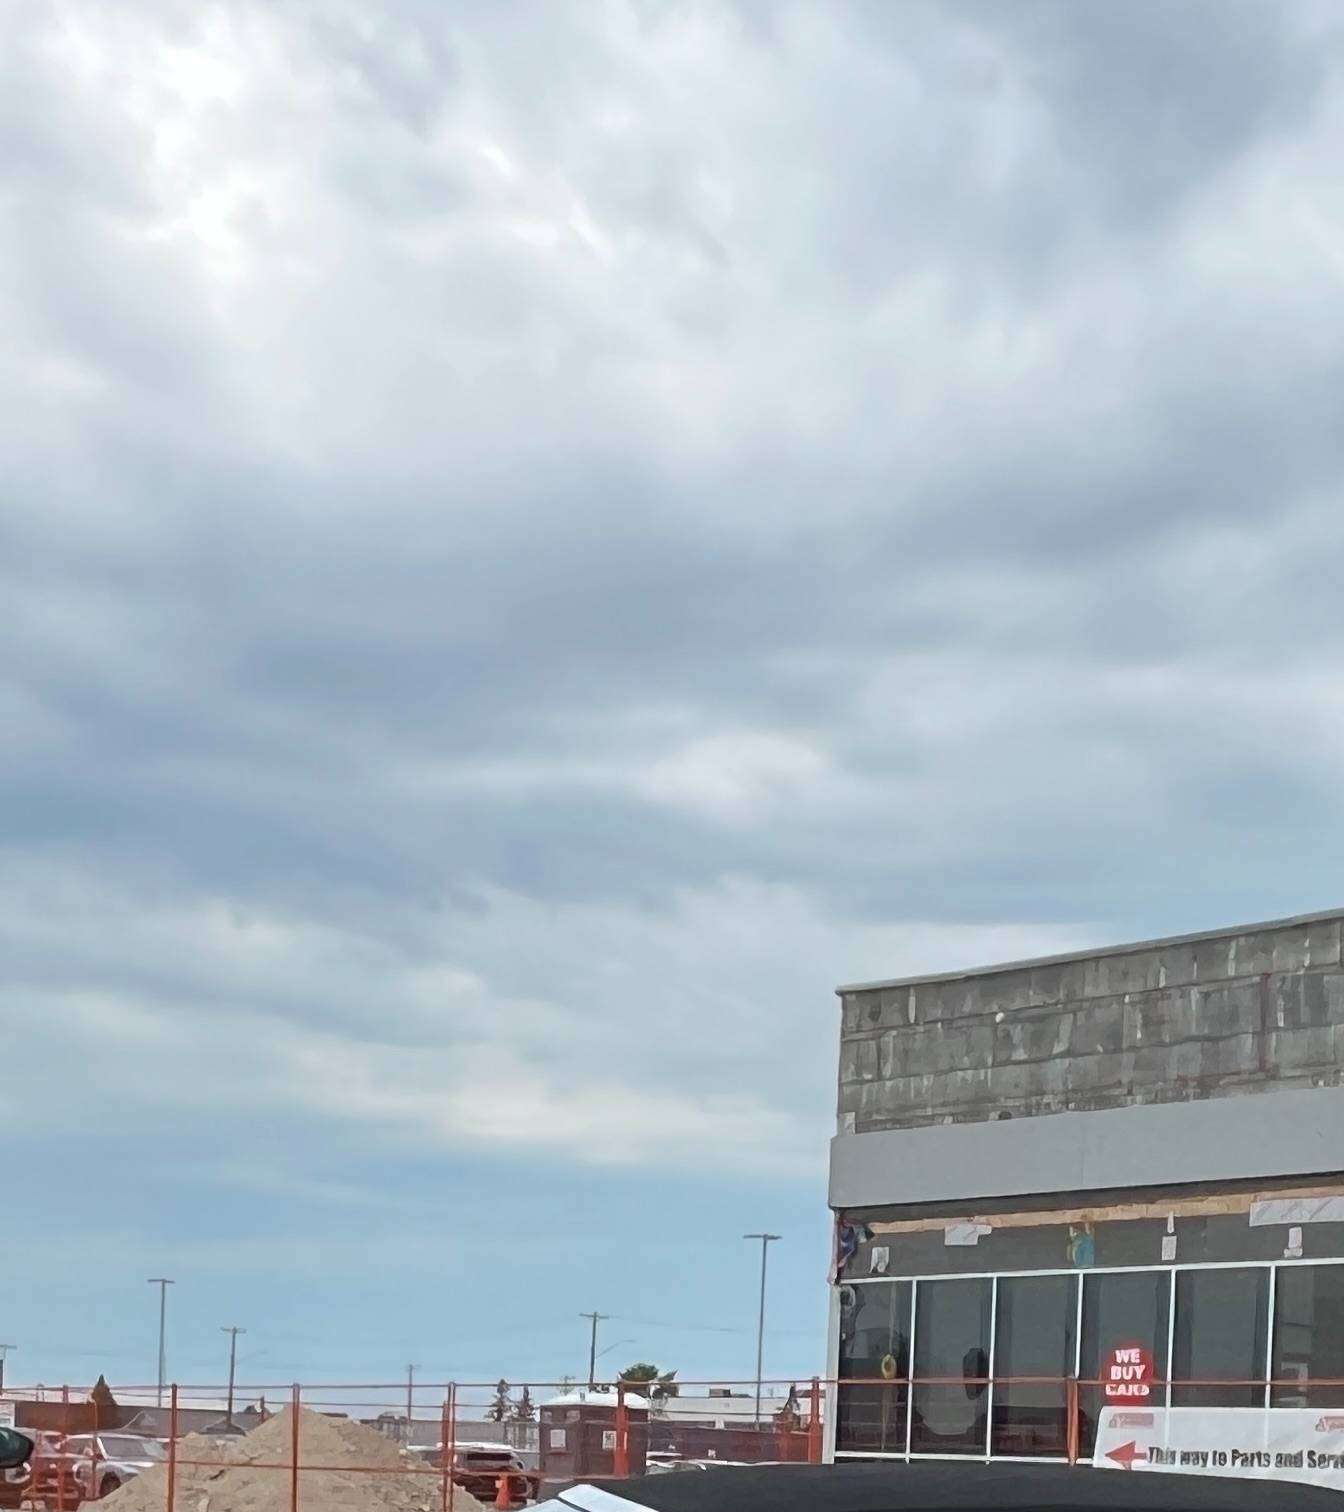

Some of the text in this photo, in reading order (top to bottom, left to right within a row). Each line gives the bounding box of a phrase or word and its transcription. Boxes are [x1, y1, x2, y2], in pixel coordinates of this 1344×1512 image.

[1115, 1348, 1141, 1364] WE
[1110, 1365, 1146, 1381] BUY
[1147, 1446, 1175, 1466] This
[1179, 1450, 1207, 1468] way
[1212, 1449, 1227, 1466] to
[1231, 1449, 1270, 1468] Parts
[1274, 1449, 1303, 1468] and
